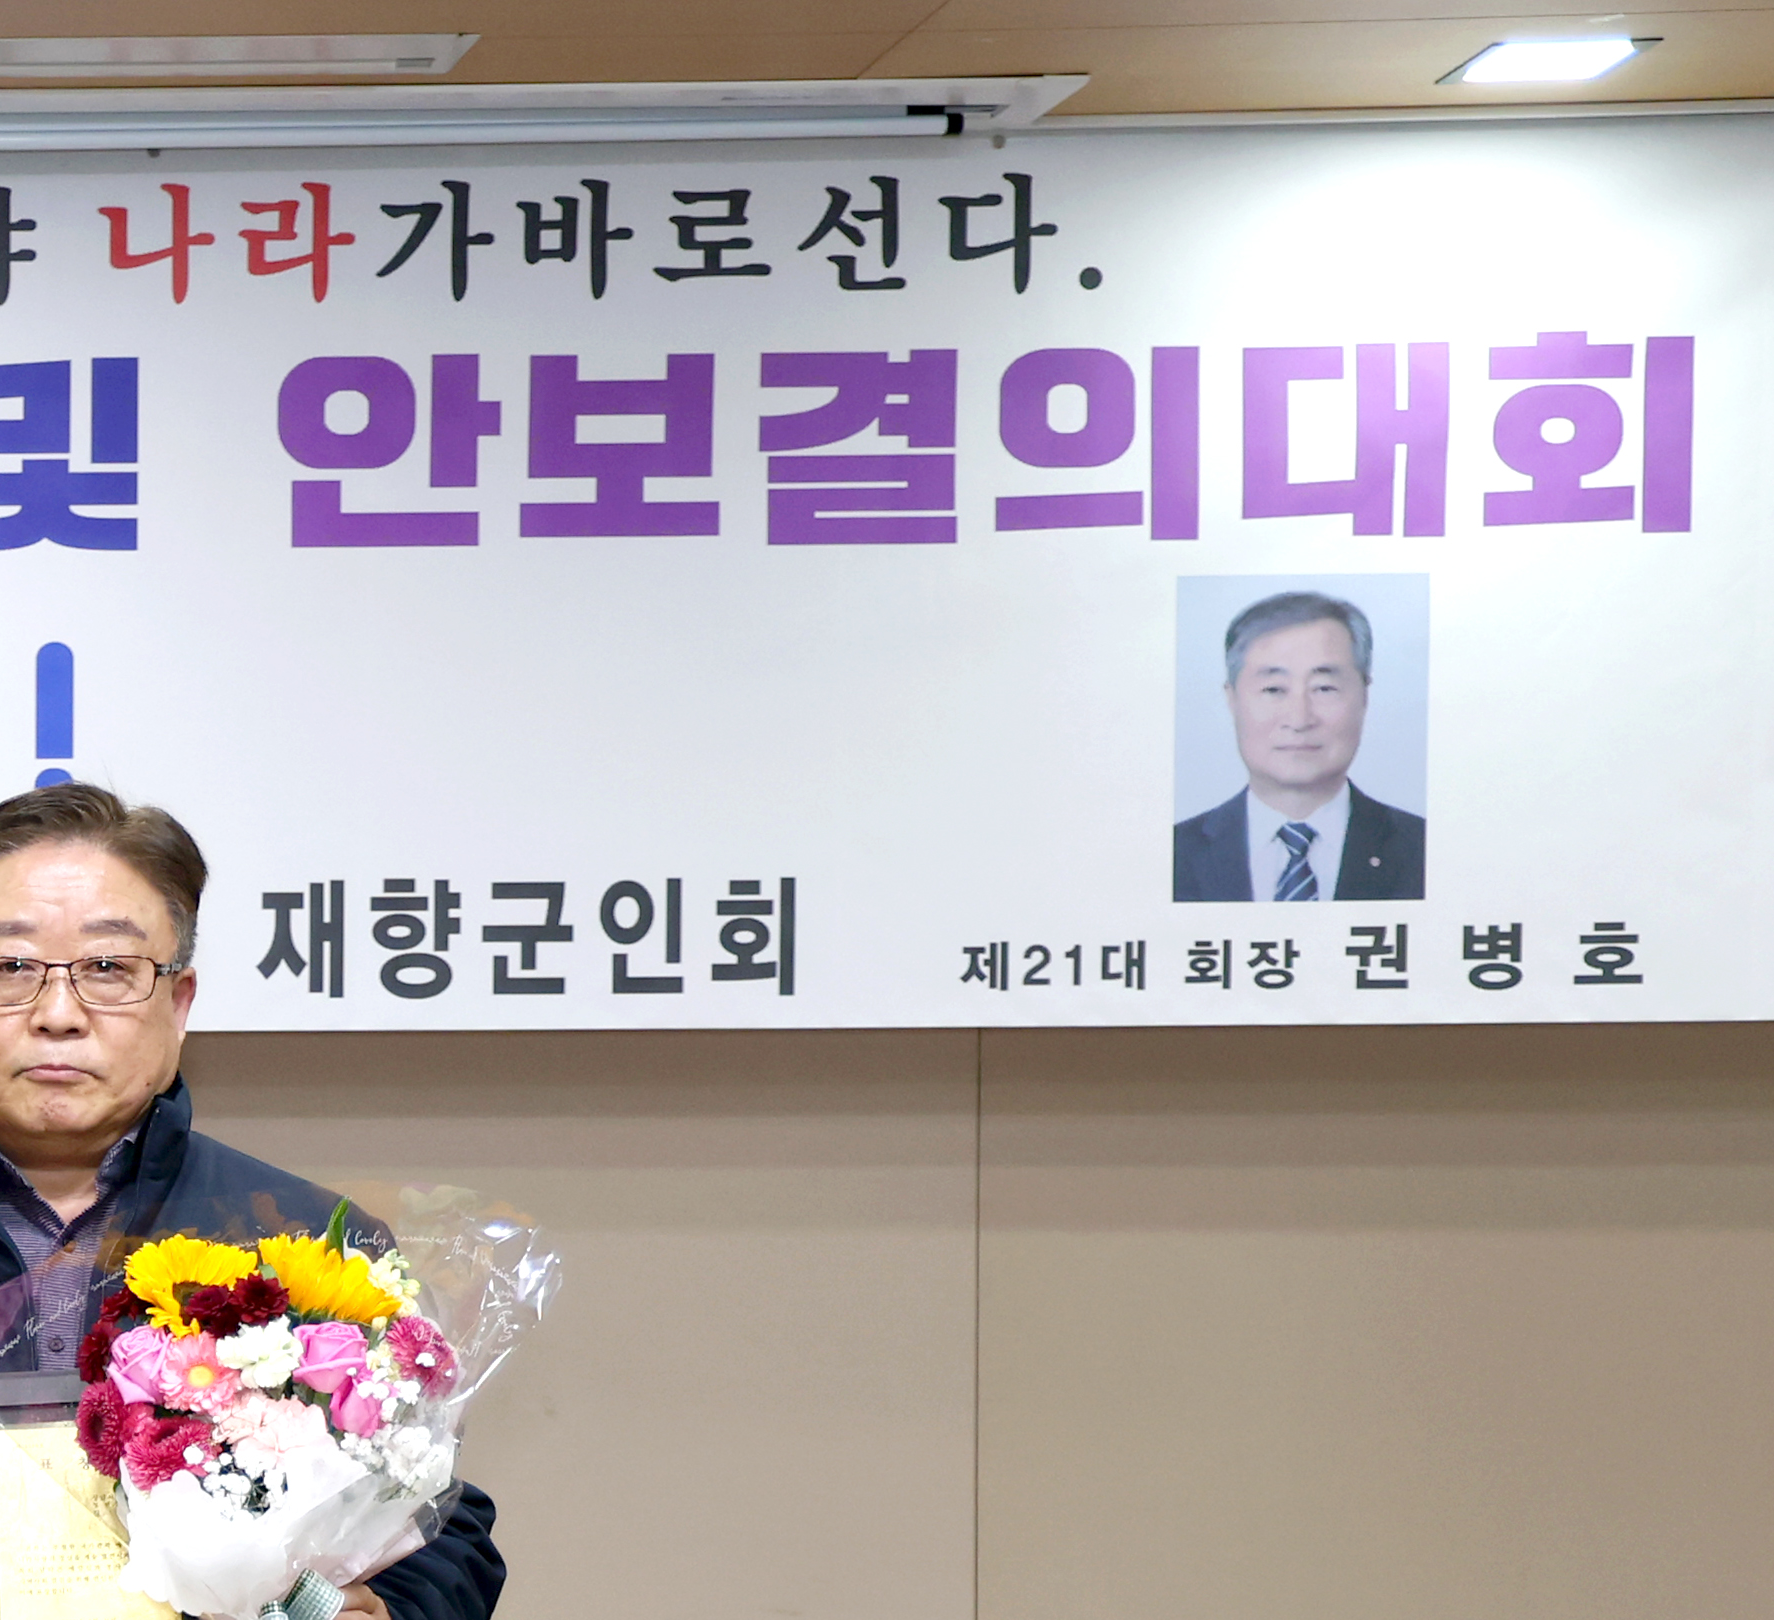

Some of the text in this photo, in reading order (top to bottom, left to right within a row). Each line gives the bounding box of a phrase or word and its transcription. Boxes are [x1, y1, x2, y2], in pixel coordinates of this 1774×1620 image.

[276, 332, 1694, 548] 안보결의대회
[257, 877, 796, 999] 재향군인회
[960, 940, 1146, 991] 제21대
[1185, 939, 1300, 989] 회장
